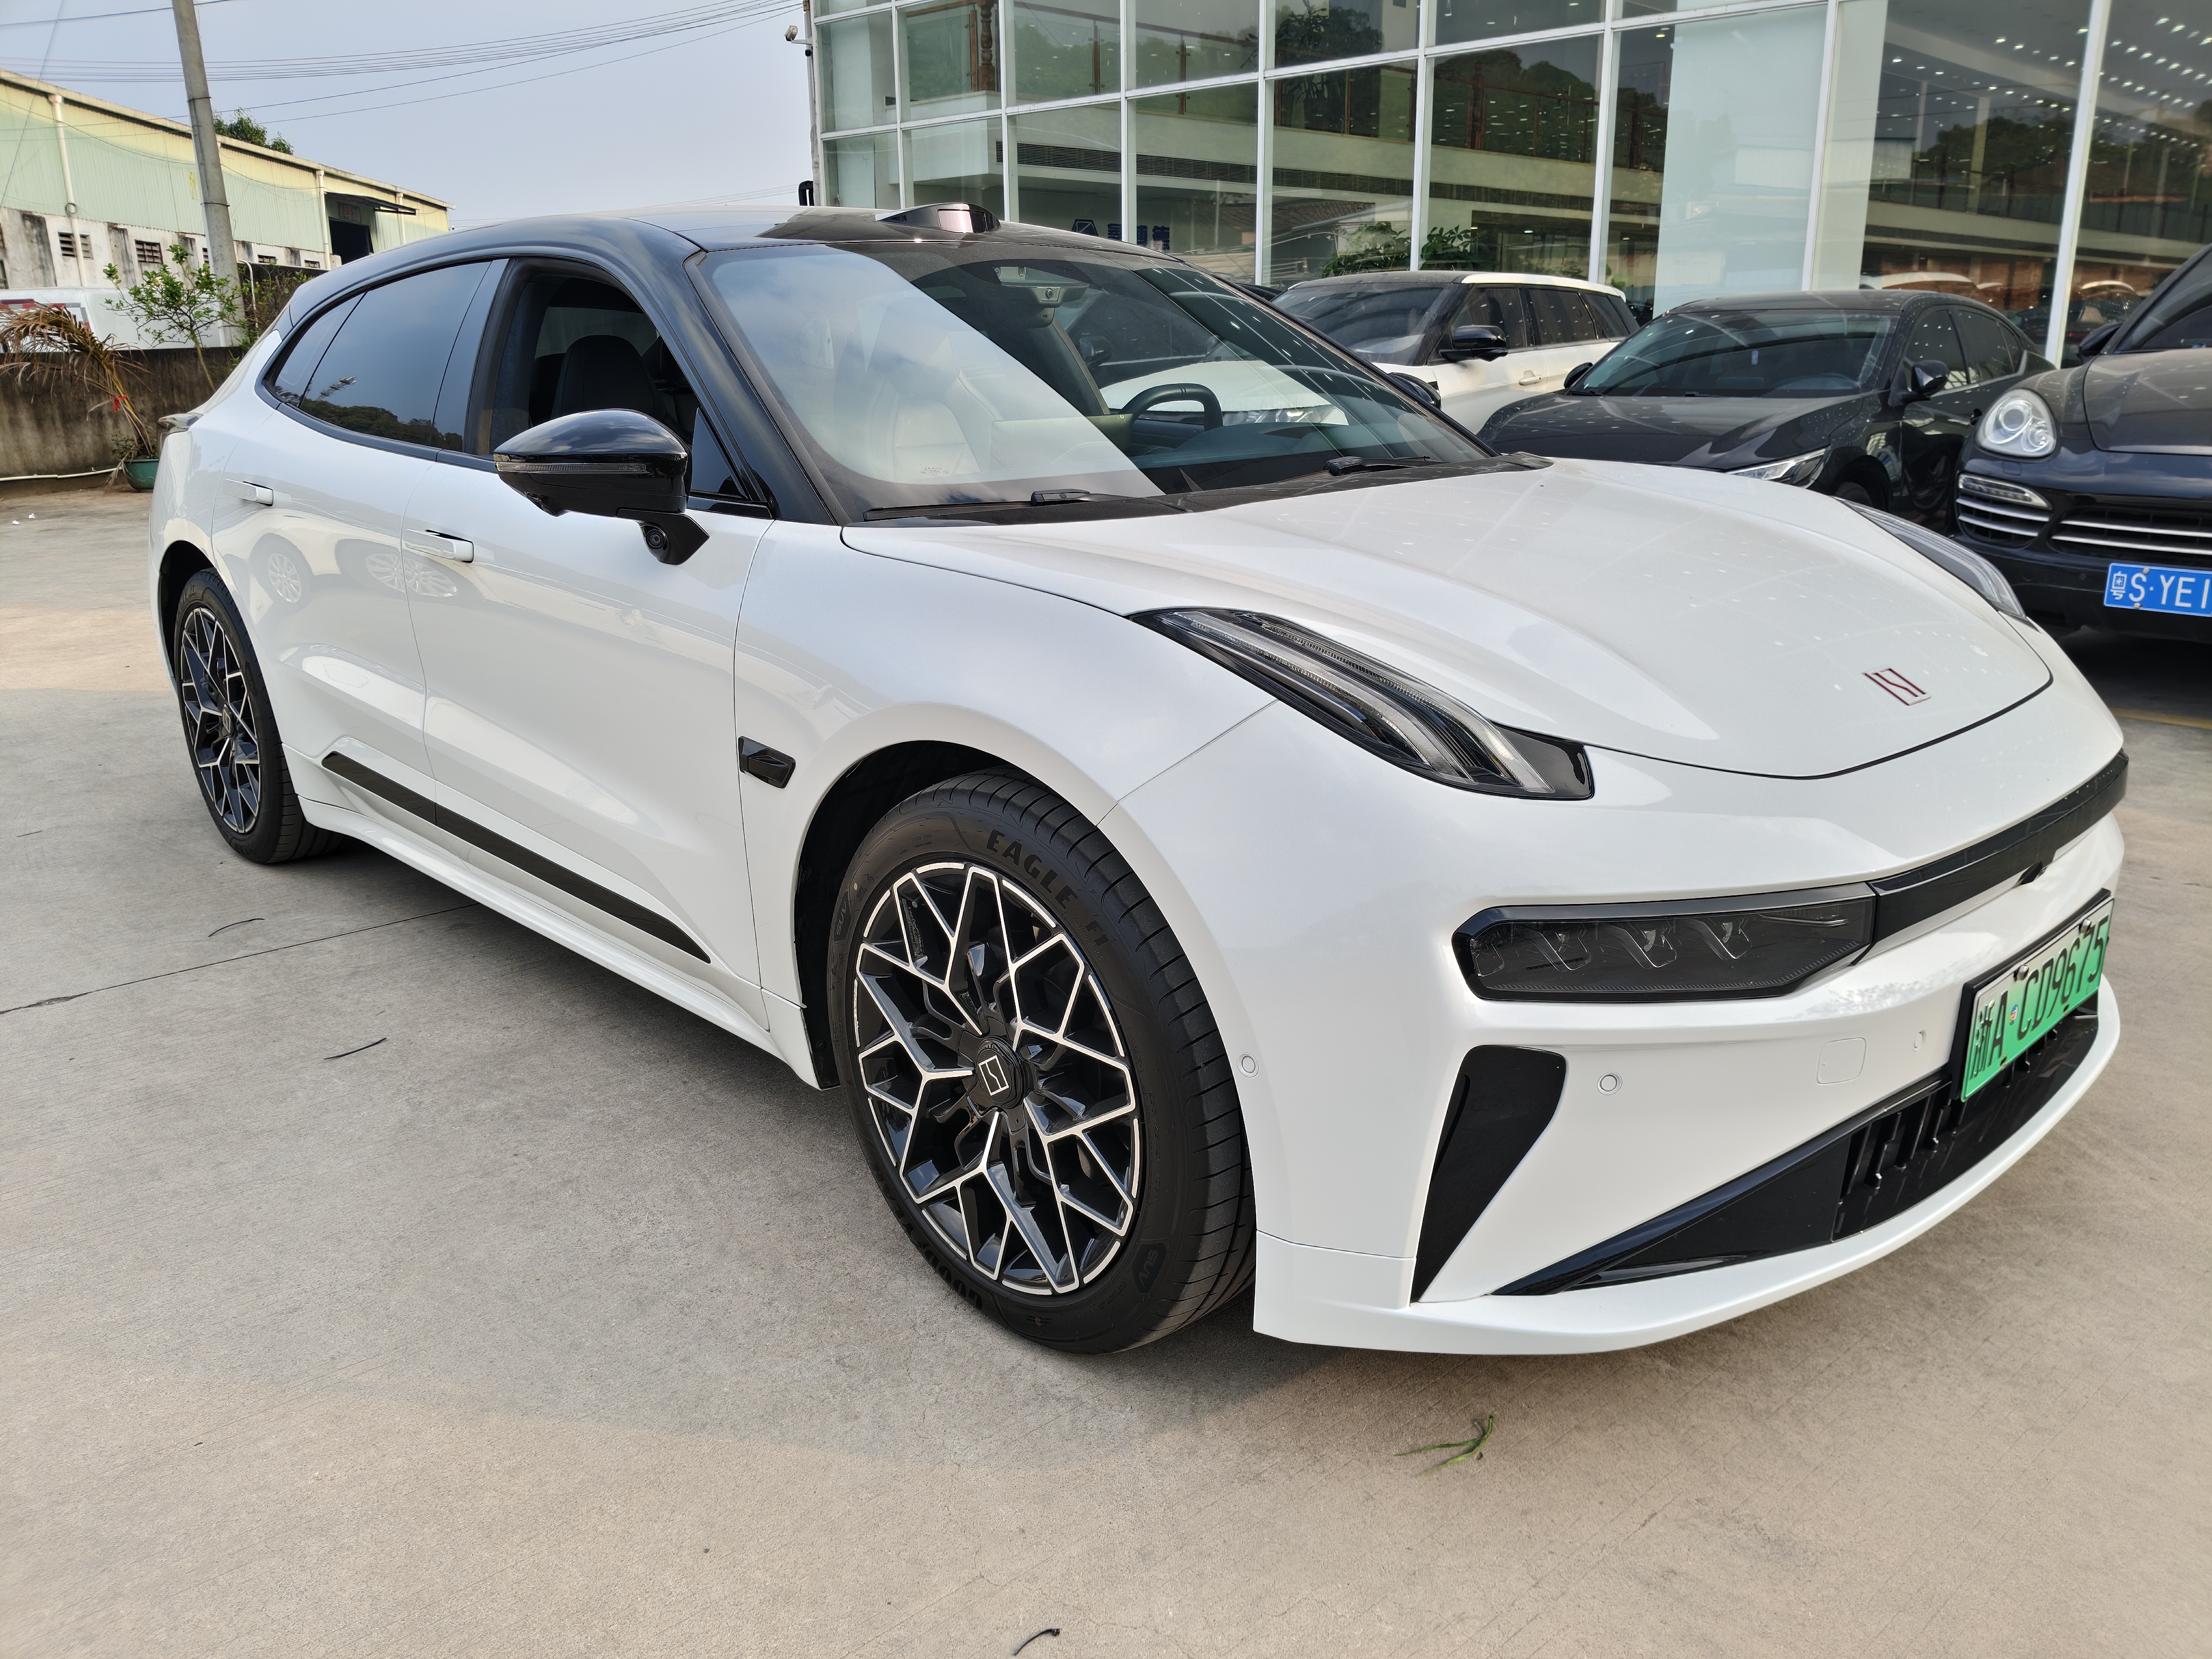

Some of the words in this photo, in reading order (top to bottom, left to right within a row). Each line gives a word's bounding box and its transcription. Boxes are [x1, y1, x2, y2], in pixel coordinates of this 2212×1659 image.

[986, 828, 1078, 909] EAGLE
[1085, 920, 1109, 946] F1
[836, 900, 847, 935] SUV
[1138, 1249, 1158, 1285] SUV
